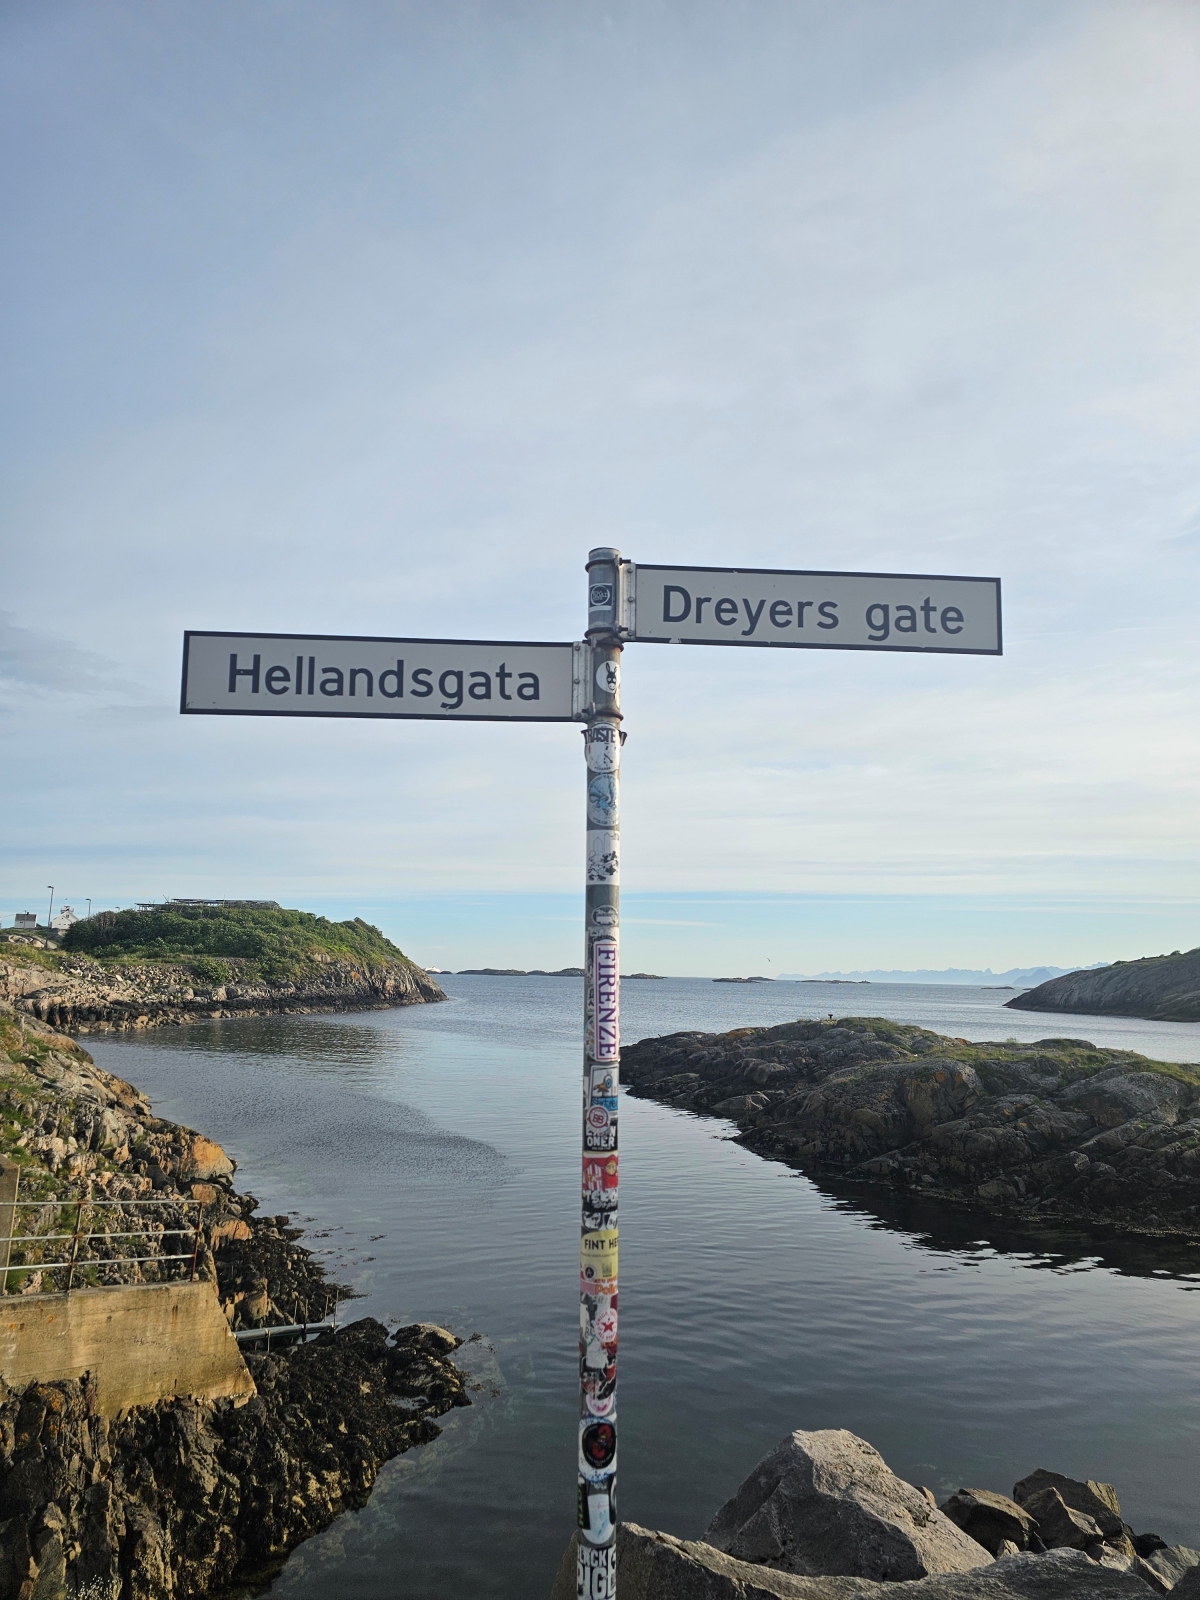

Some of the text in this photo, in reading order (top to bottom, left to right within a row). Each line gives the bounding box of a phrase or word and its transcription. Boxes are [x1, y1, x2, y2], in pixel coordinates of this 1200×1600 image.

[662, 584, 965, 642] Dreyers gate
[227, 653, 541, 710] Hellandsgata
[598, 947, 616, 1057] FIRENZE
[584, 1239, 605, 1250] FINT
